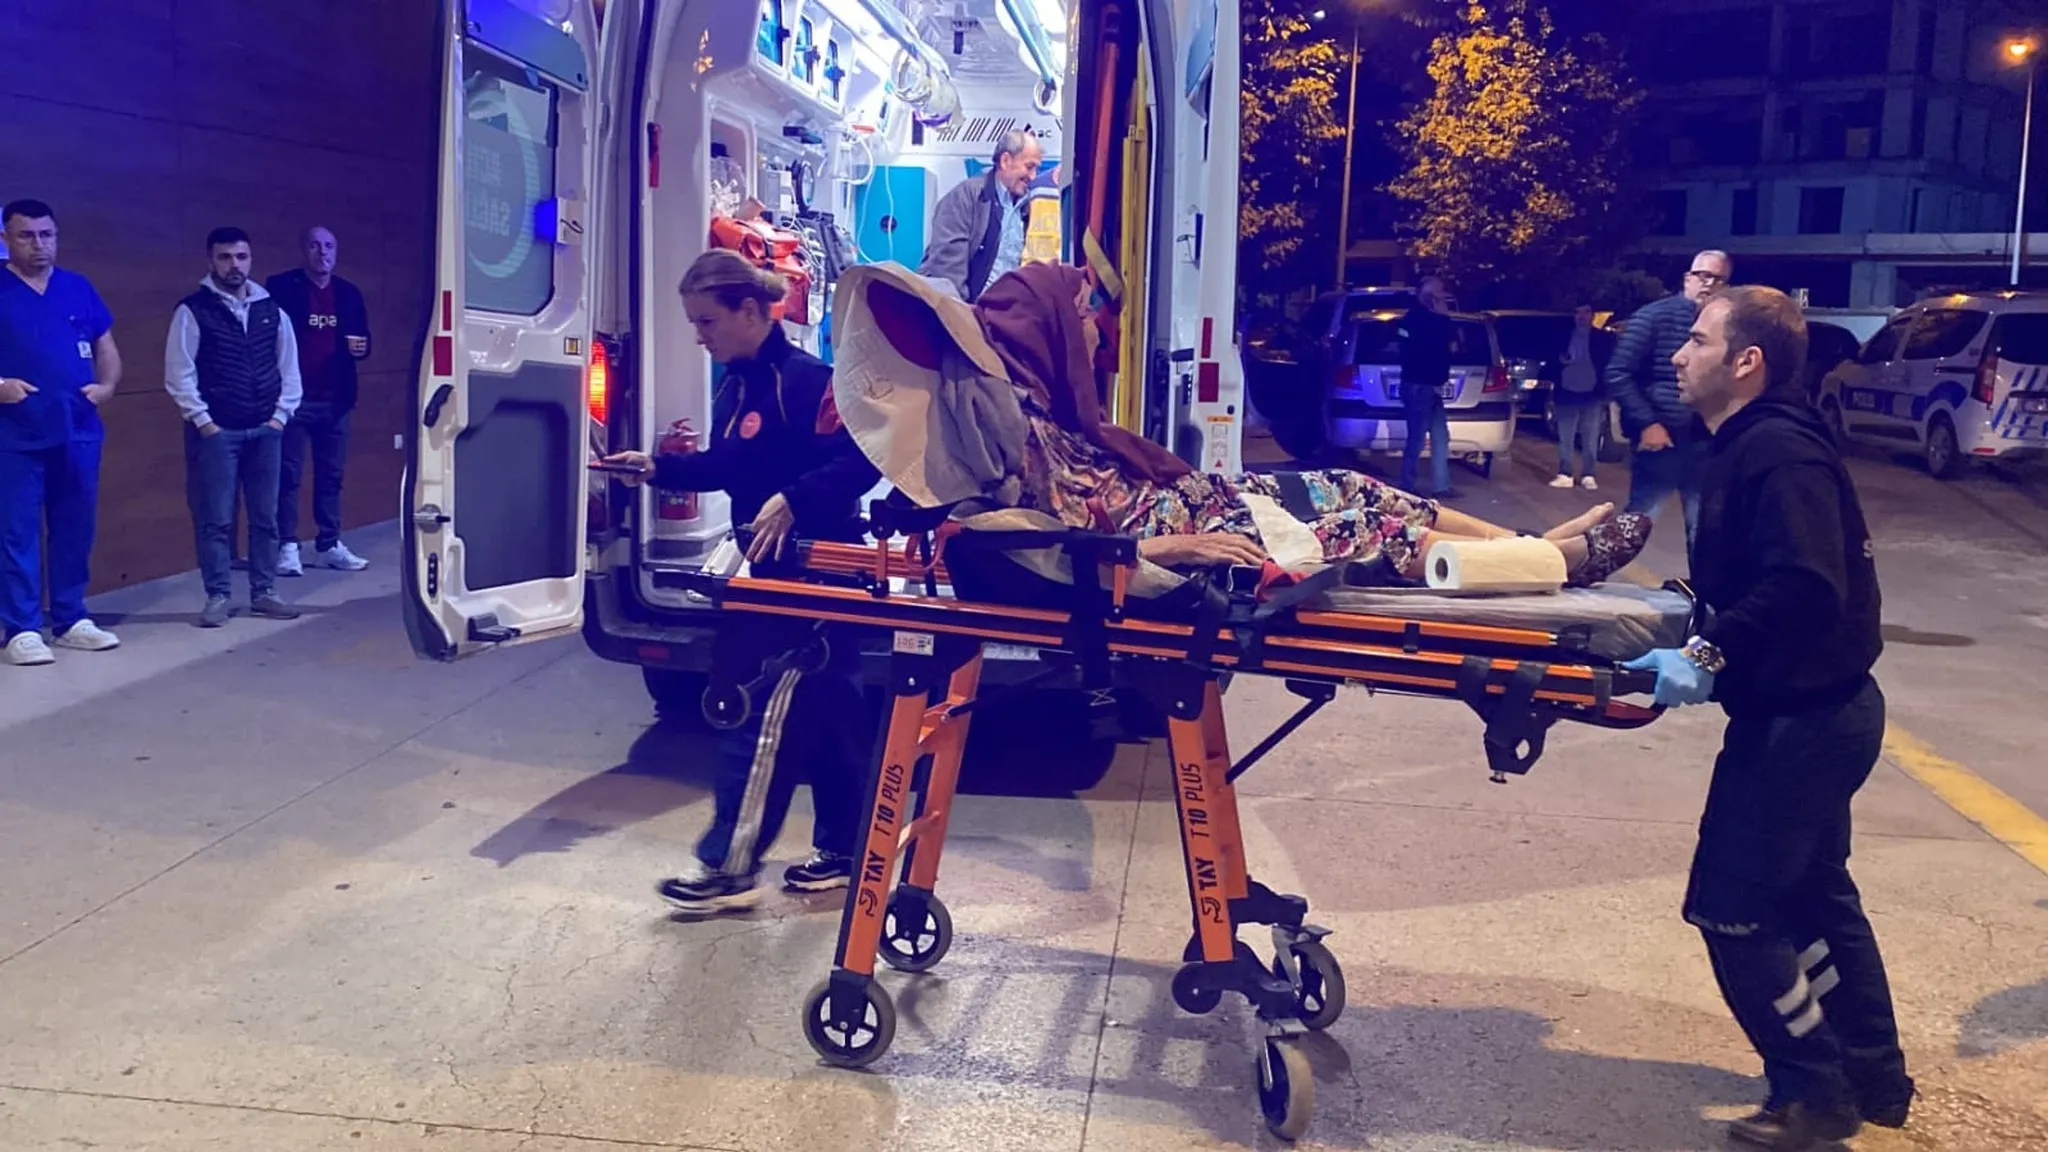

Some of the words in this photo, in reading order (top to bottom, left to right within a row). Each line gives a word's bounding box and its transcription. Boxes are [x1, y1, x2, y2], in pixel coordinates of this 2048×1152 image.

[881, 763, 904, 803] PLUS
[1180, 762, 1205, 803] PLUS
[876, 804, 895, 824] 10
[1187, 808, 1209, 827] 10
[864, 850, 885, 883] TAY
[1195, 857, 1218, 892] TAY
